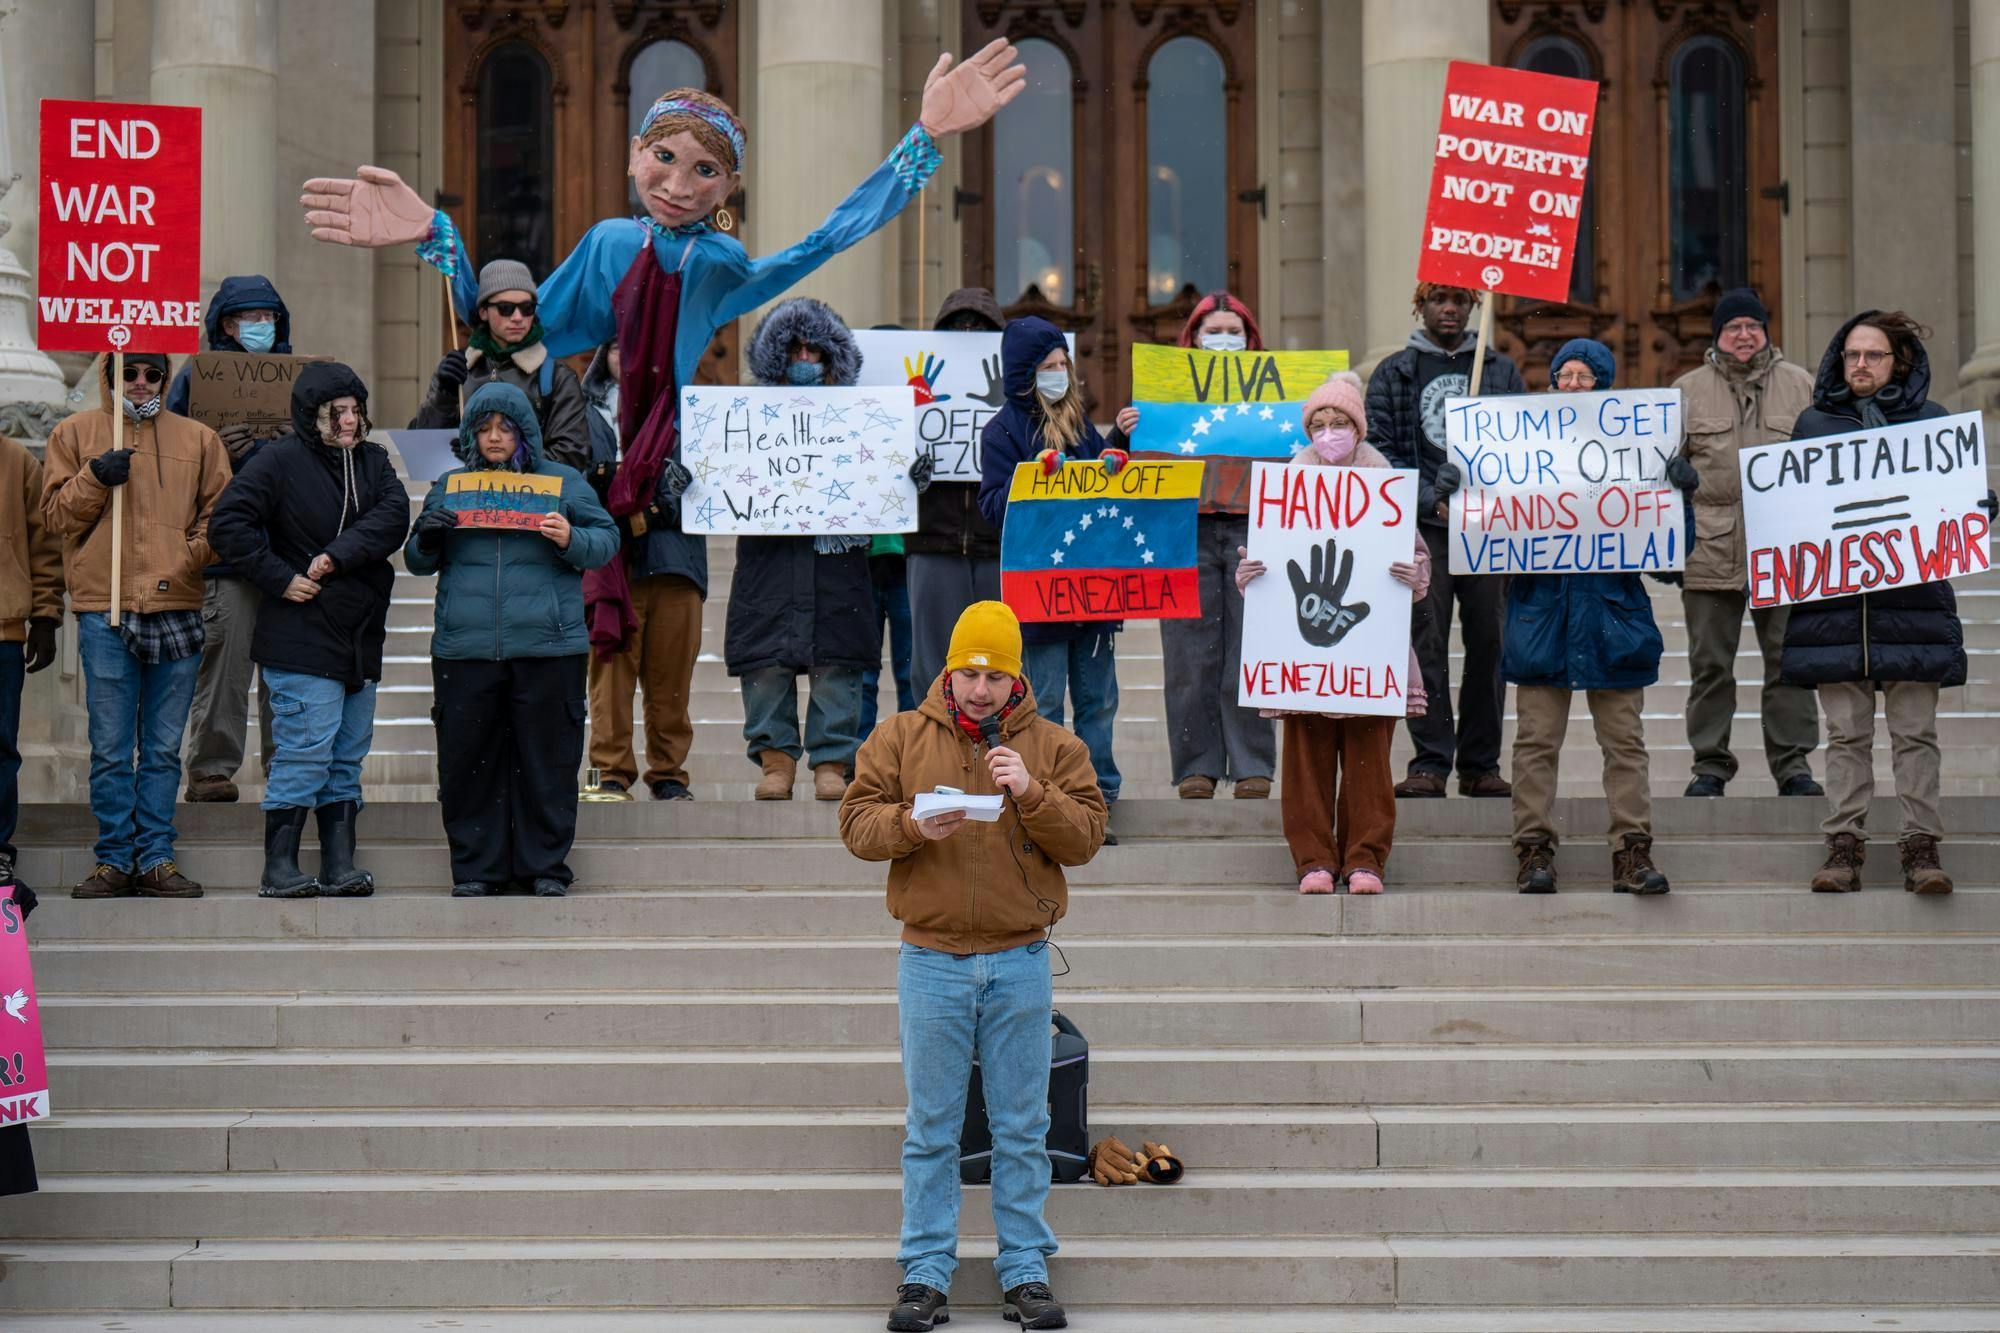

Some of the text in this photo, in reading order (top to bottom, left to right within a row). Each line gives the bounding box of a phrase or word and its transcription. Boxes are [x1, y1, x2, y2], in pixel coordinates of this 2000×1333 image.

[1448, 93, 1589, 137] WAR ON
[70, 118, 161, 160] END
[1436, 133, 1589, 180] POVERTY
[51, 181, 156, 226] WAR
[1441, 175, 1581, 219] NOT ON
[67, 241, 161, 283] NOT
[1429, 226, 1562, 270] PEOPLE!
[38, 296, 200, 327] WELFARE
[1187, 353, 1286, 403] VIVA
[919, 407, 997, 442] OFF
[1450, 397, 1677, 443] TRUMP, GET
[768, 454, 822, 477] NOT
[1453, 439, 1678, 487] YOUR OILY
[1747, 421, 1979, 493] CAPITALISM
[1031, 465, 1174, 495] HANDS OFF
[1257, 467, 1406, 531] HANDS
[723, 489, 814, 522] Warfare
[1462, 486, 1673, 531] HANDS OFF
[1461, 527, 1676, 573] VENEZUELA!
[1751, 513, 1989, 607] ENDLESS WAR
[1035, 573, 1178, 617] VENEZUELA
[1300, 592, 1356, 636] OFF
[1243, 660, 1402, 699] VENEZUELA
